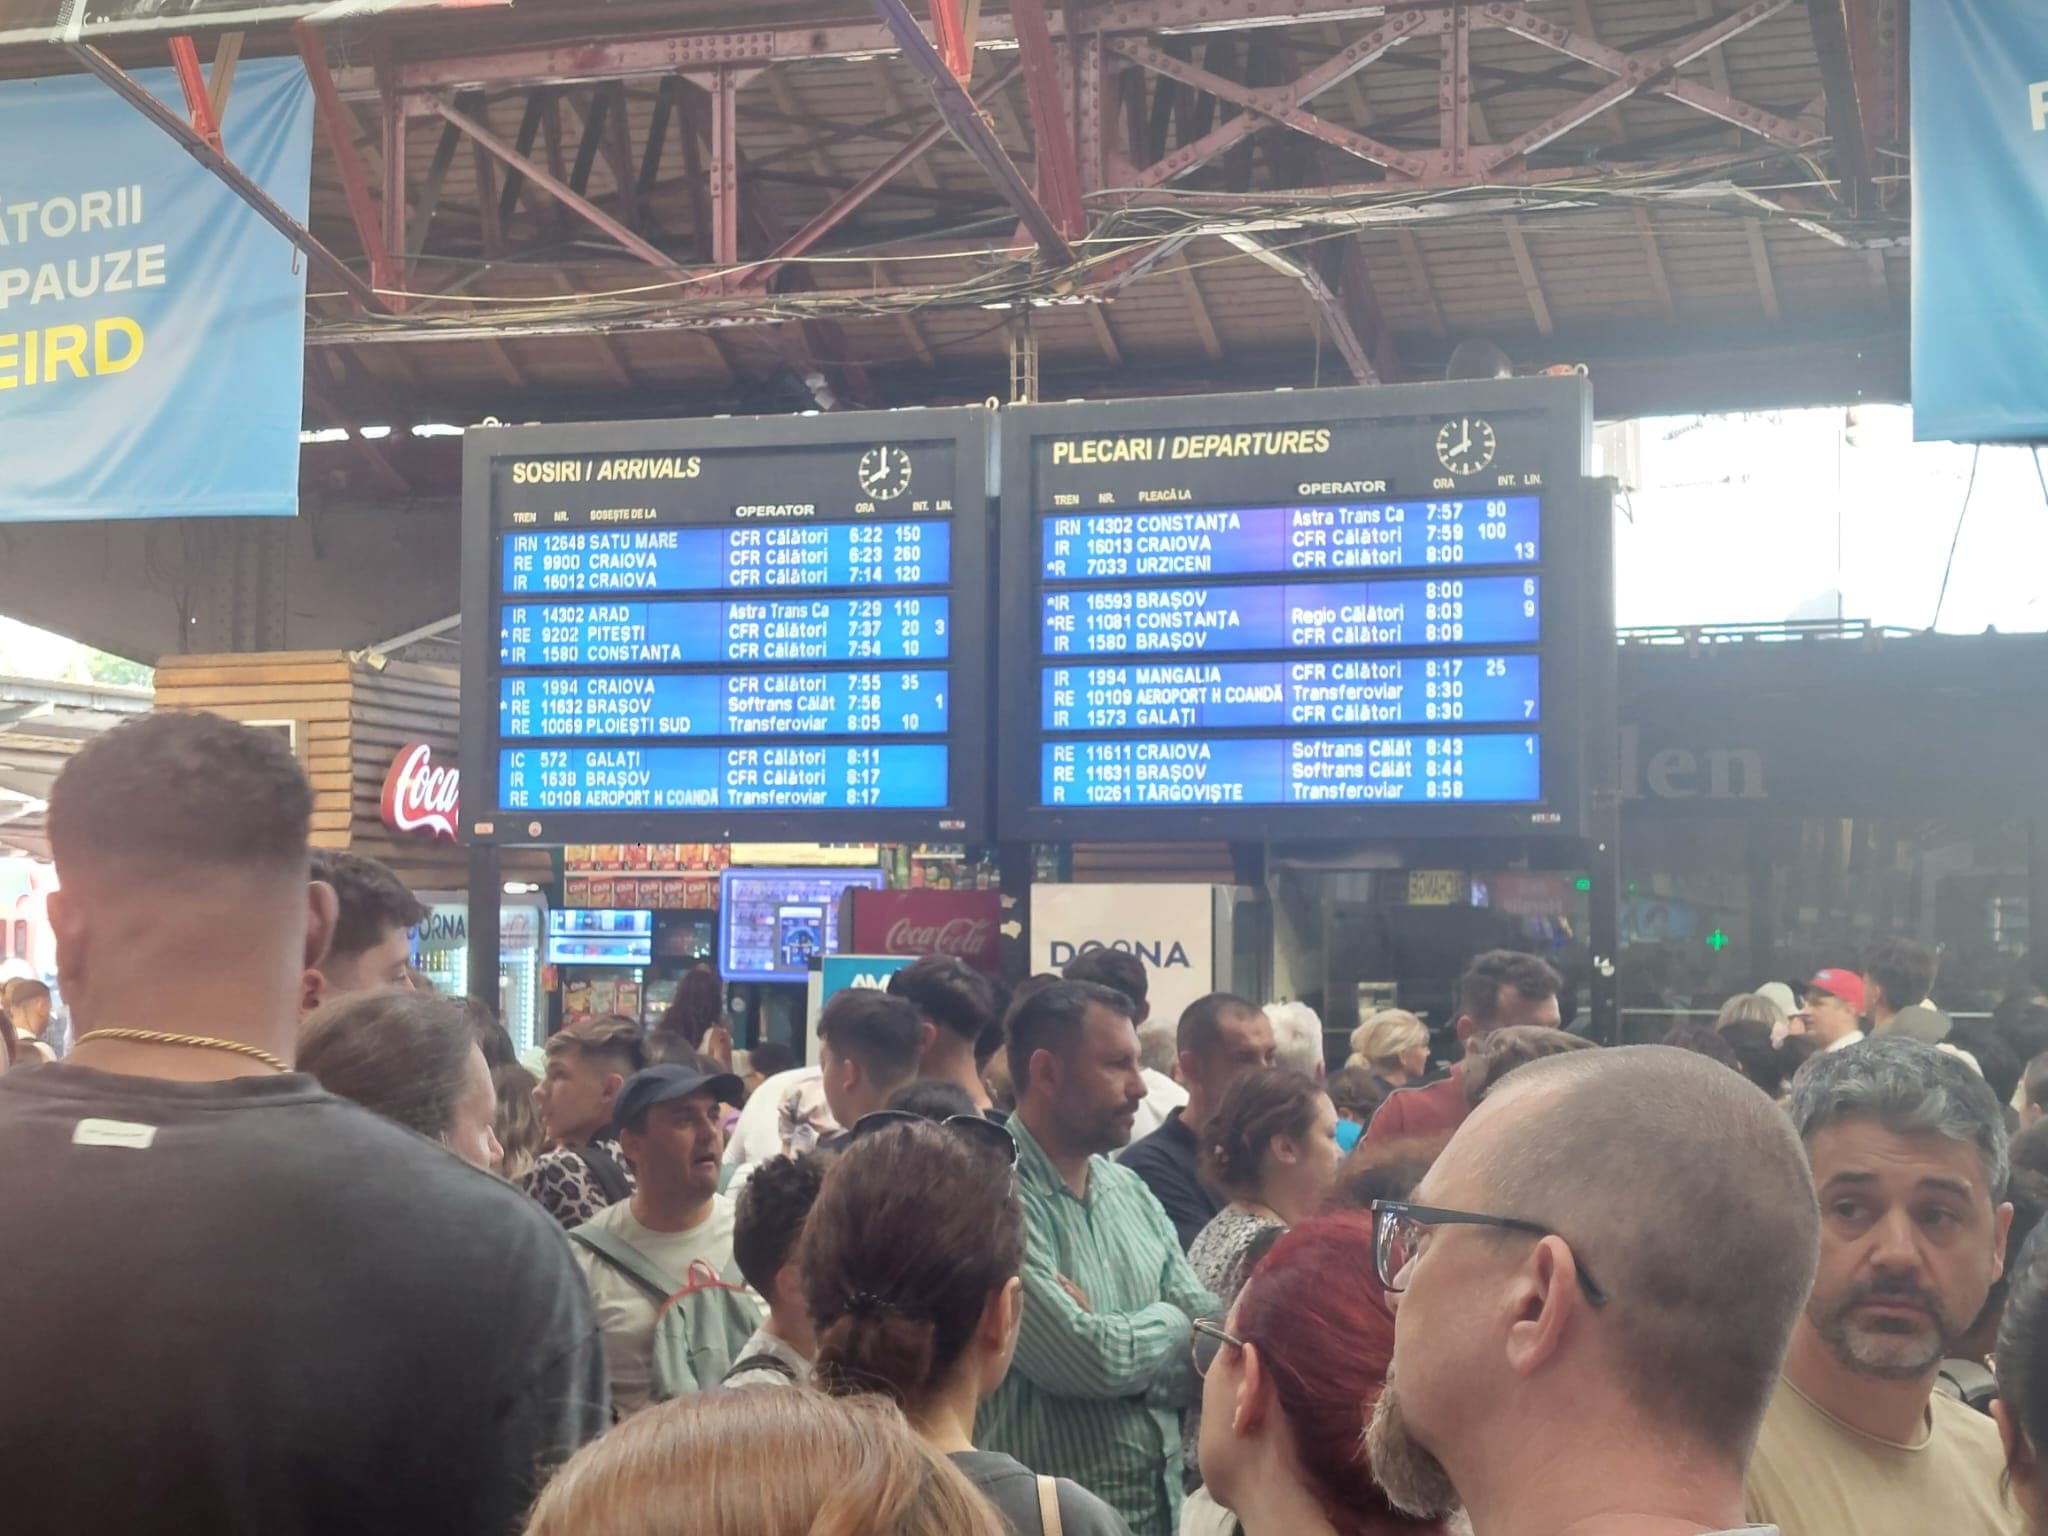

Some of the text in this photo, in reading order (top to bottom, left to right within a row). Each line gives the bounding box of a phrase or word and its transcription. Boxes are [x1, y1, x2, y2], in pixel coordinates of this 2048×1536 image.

[0, 184, 141, 246] TORII
[0, 244, 166, 309] PAUZE
[1171, 429, 1331, 459] DEPARTURES
[513, 461, 581, 483] SOSIRI
[597, 456, 701, 480] ARRIVALS
[1054, 494, 1079, 505] TREN
[1178, 490, 1191, 500] LA
[1299, 480, 1385, 495] OPERATOR
[1433, 478, 1455, 489] ORA
[513, 512, 537, 523] TREN
[735, 504, 815, 517] OPERATOR
[1056, 520, 1080, 535] IRN
[1293, 510, 1333, 527] Astra
[1339, 508, 1380, 524] Trans
[1386, 506, 1404, 522] Ca
[515, 537, 537, 552] IRN
[590, 534, 630, 550] SATU
[636, 532, 677, 548] MARE
[731, 530, 760, 546] CFR
[1056, 540, 1069, 555] IR
[1137, 535, 1211, 553] CRAIOVA
[1292, 530, 1326, 547] CFR
[514, 556, 532, 571] RE
[590, 553, 656, 569] CRAIOVA
[730, 550, 760, 565] CFR
[1055, 560, 1065, 576] R
[1137, 555, 1211, 573] URZICENI
[1293, 551, 1326, 568] CFR
[514, 575, 527, 590] IR
[590, 572, 656, 588] CRAIOVA
[730, 569, 760, 586] CFR
[513, 608, 526, 624] IR
[589, 607, 629, 622] ARAD
[730, 604, 766, 619] Astra
[771, 603, 807, 618] Trans
[812, 602, 829, 618] Ca
[1055, 595, 1069, 611] IR
[1055, 615, 1074, 631] RE
[1292, 607, 1336, 626] Regio
[512, 628, 530, 643] RE
[729, 623, 759, 639] CFR
[1055, 636, 1069, 651] IR
[1293, 627, 1325, 644] CFR
[512, 647, 526, 662] IR
[729, 643, 758, 658] CFR
[1055, 670, 1069, 686] IR
[1137, 667, 1221, 684] MANGALIA
[1292, 664, 1325, 681] CFR
[512, 681, 525, 696] IR
[588, 679, 654, 694] CRAIOVA
[729, 677, 758, 693] CFR
[1055, 691, 1074, 706] RE
[1137, 688, 1207, 705] AEROPORT
[1292, 683, 1403, 701] Transferoviar
[512, 700, 530, 715] RE
[728, 697, 792, 712] Softrans
[1054, 711, 1068, 726] IR
[1292, 705, 1325, 722] CFR
[512, 719, 530, 734] RE
[660, 717, 690, 733] SUD
[728, 716, 827, 732] Transferoviar
[511, 752, 524, 768] IC
[728, 750, 757, 765] CFR
[1055, 746, 1074, 762] RE
[1137, 744, 1210, 760] CRAIOVA
[1293, 742, 1363, 758] Softrans
[511, 771, 524, 786] IR
[728, 770, 757, 785] CFR
[1054, 762, 1363, 781] RE Softrans
[510, 789, 826, 806] RE AEROPORT Transferoviar
[1054, 786, 1064, 802] R
[1292, 781, 1403, 799] Transferoviar
